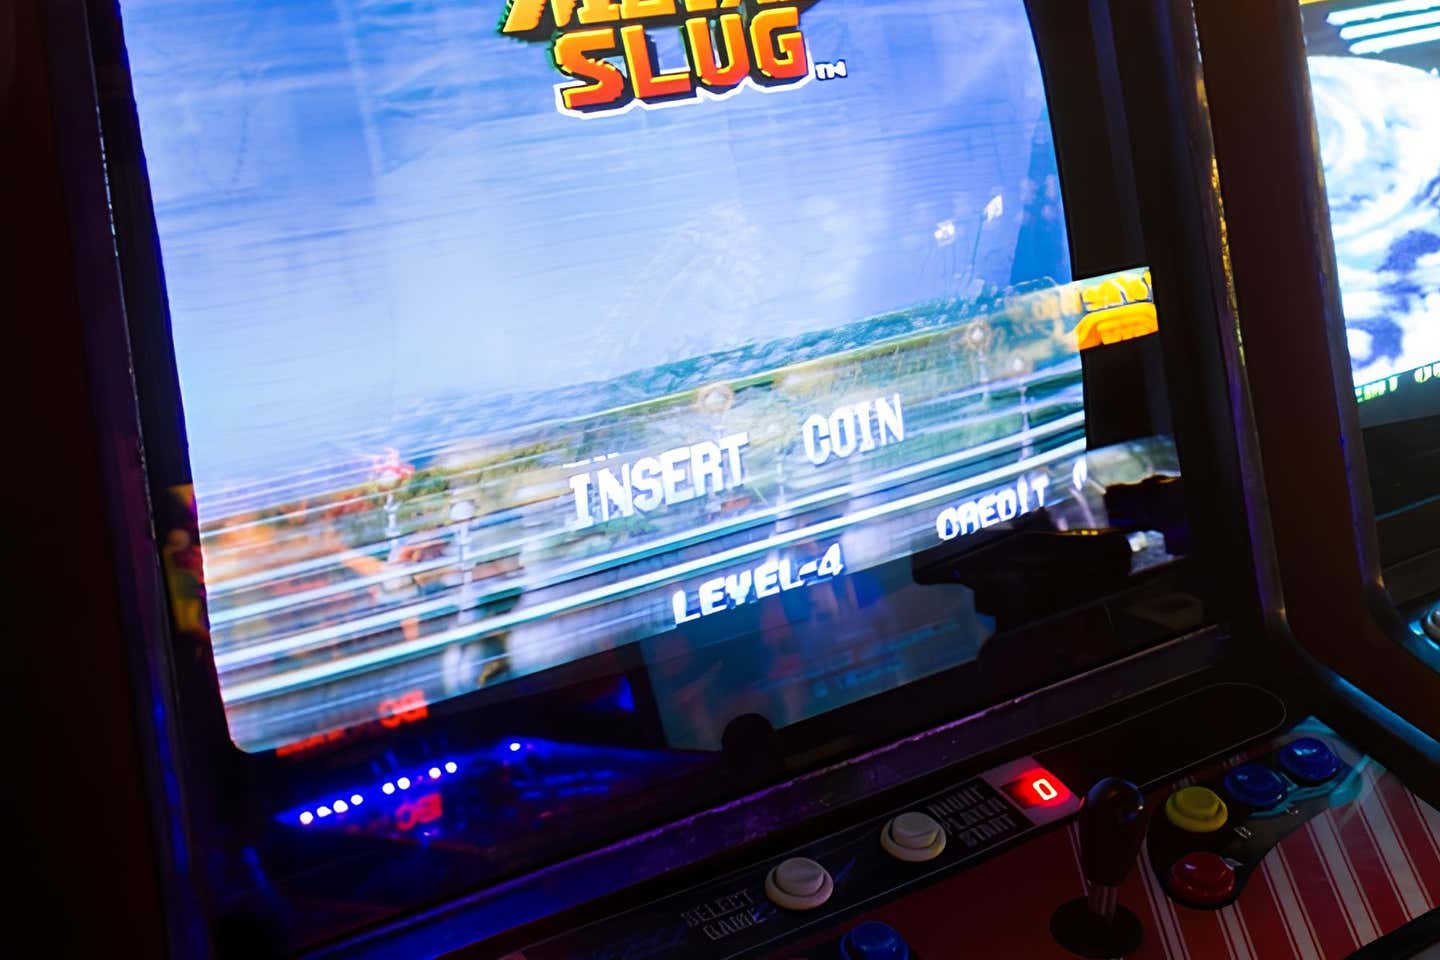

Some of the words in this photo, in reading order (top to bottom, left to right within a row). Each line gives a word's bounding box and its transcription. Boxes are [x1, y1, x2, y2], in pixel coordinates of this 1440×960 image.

[553, 6, 812, 114] SLUG
[567, 433, 749, 528] INSERT
[801, 393, 906, 466] COIN
[672, 543, 844, 625] LEVEL-4
[1032, 778, 1059, 801] 0
[681, 888, 755, 927] SELECT
